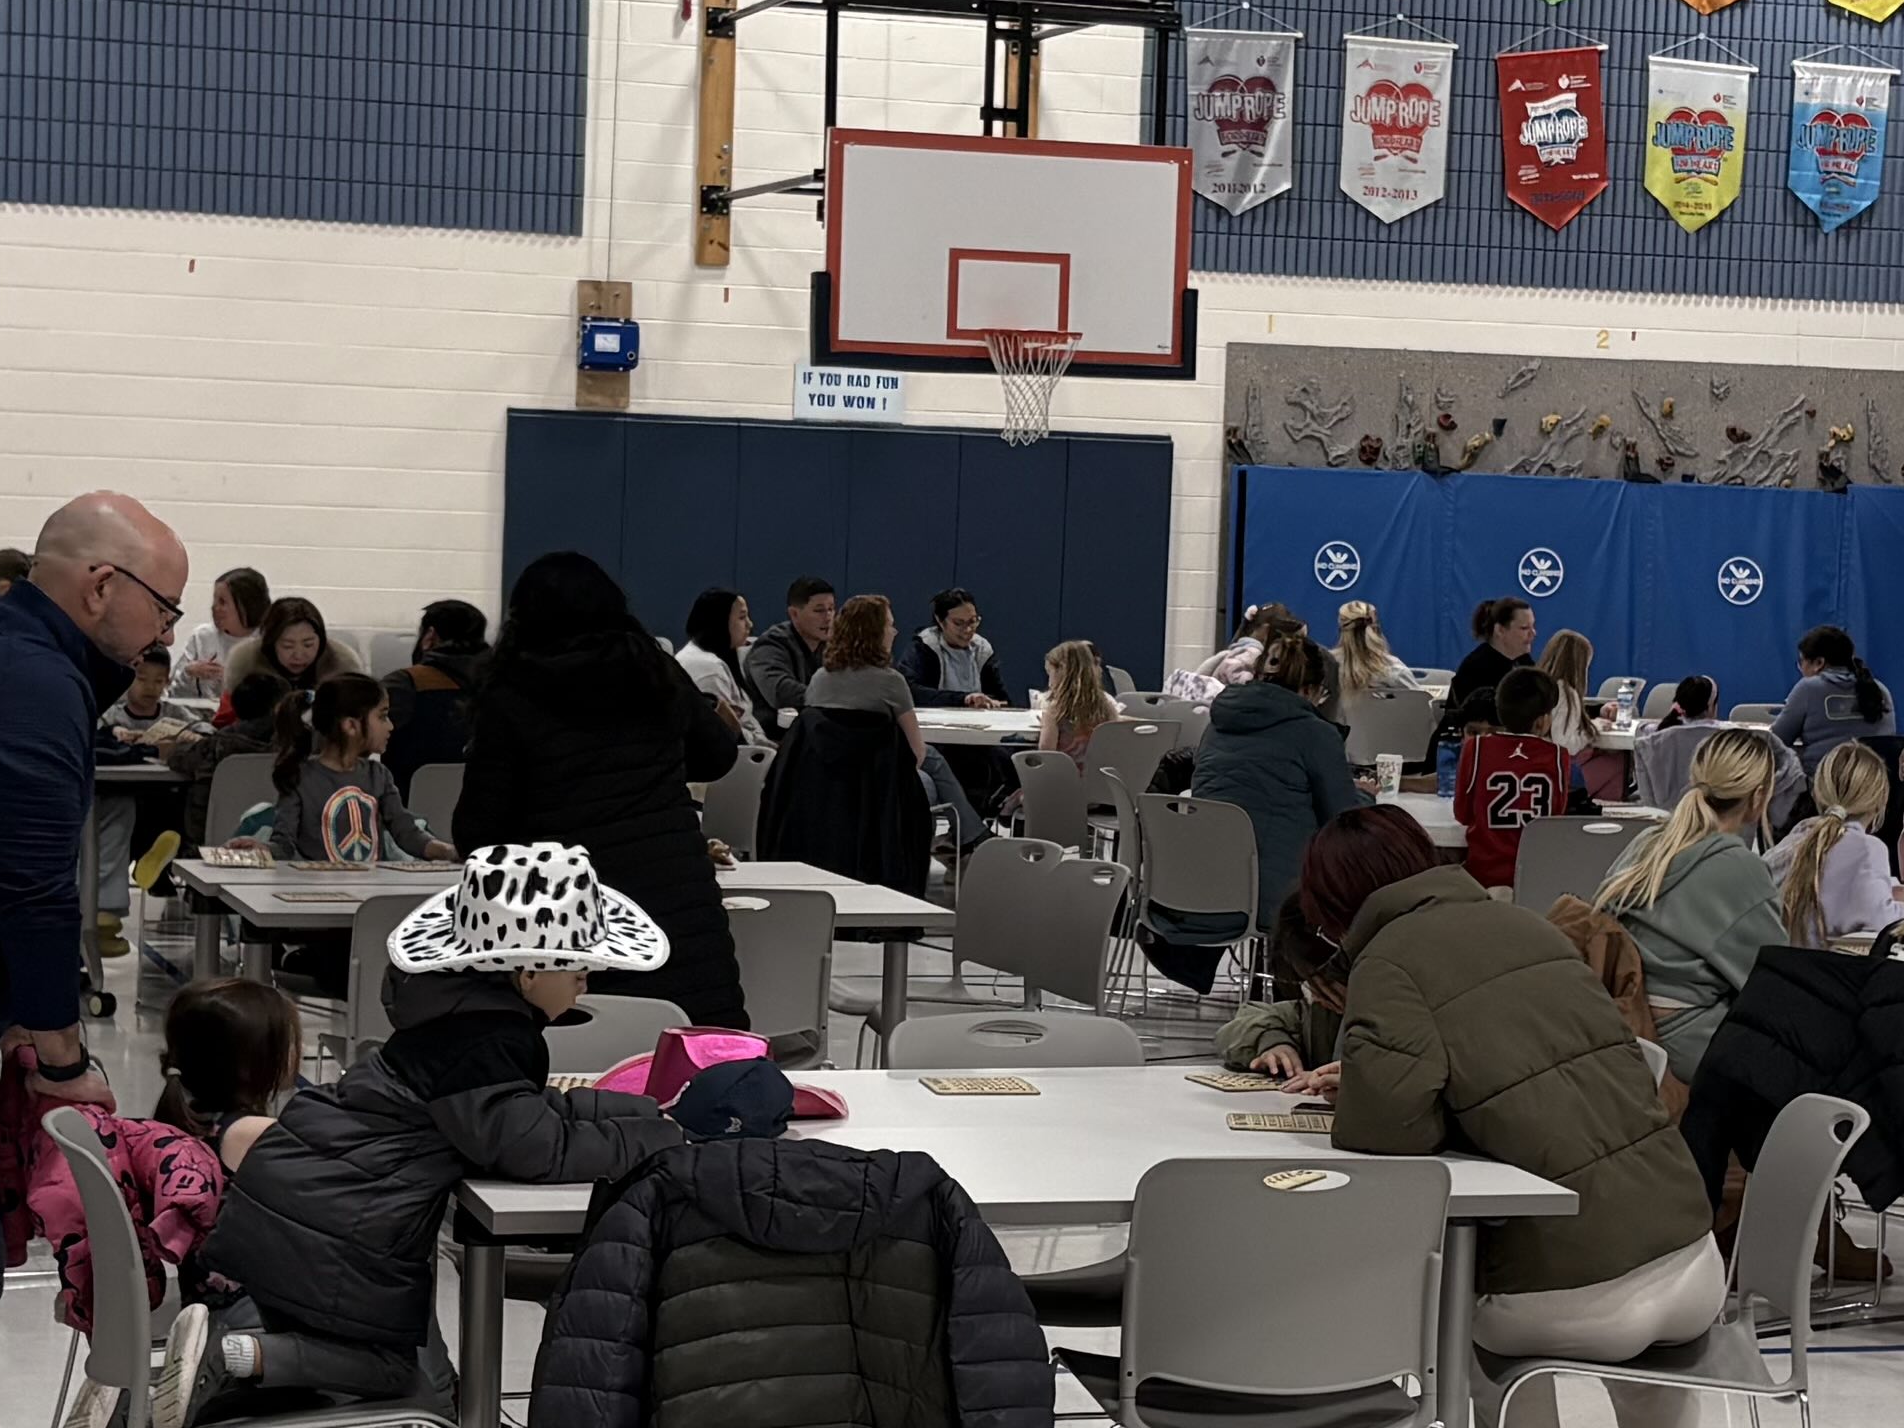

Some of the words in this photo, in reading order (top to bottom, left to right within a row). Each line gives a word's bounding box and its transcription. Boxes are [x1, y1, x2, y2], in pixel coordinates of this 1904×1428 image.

[1195, 93, 1242, 121] JUMP
[1243, 93, 1286, 121] ROPE
[1351, 96, 1396, 126] JUMP
[1398, 99, 1441, 128] ROPE
[1520, 121, 1557, 145] JUMP
[1555, 117, 1589, 141] ROPE
[1652, 122, 1694, 150] JUMP
[1695, 123, 1735, 152] ROPE
[1797, 124, 1837, 152] JUMP
[1838, 126, 1878, 154] ROPE
[1212, 182, 1266, 195] 2011-2012
[1362, 186, 1418, 201] 2012-2013
[1596, 330, 1609, 348] 2
[803, 372, 813, 385] IF
[819, 373, 842, 386] YOU
[876, 376, 899, 390] FUN
[808, 393, 836, 407] YOU
[843, 395, 876, 410] WON
[1487, 772, 1552, 828] 23
